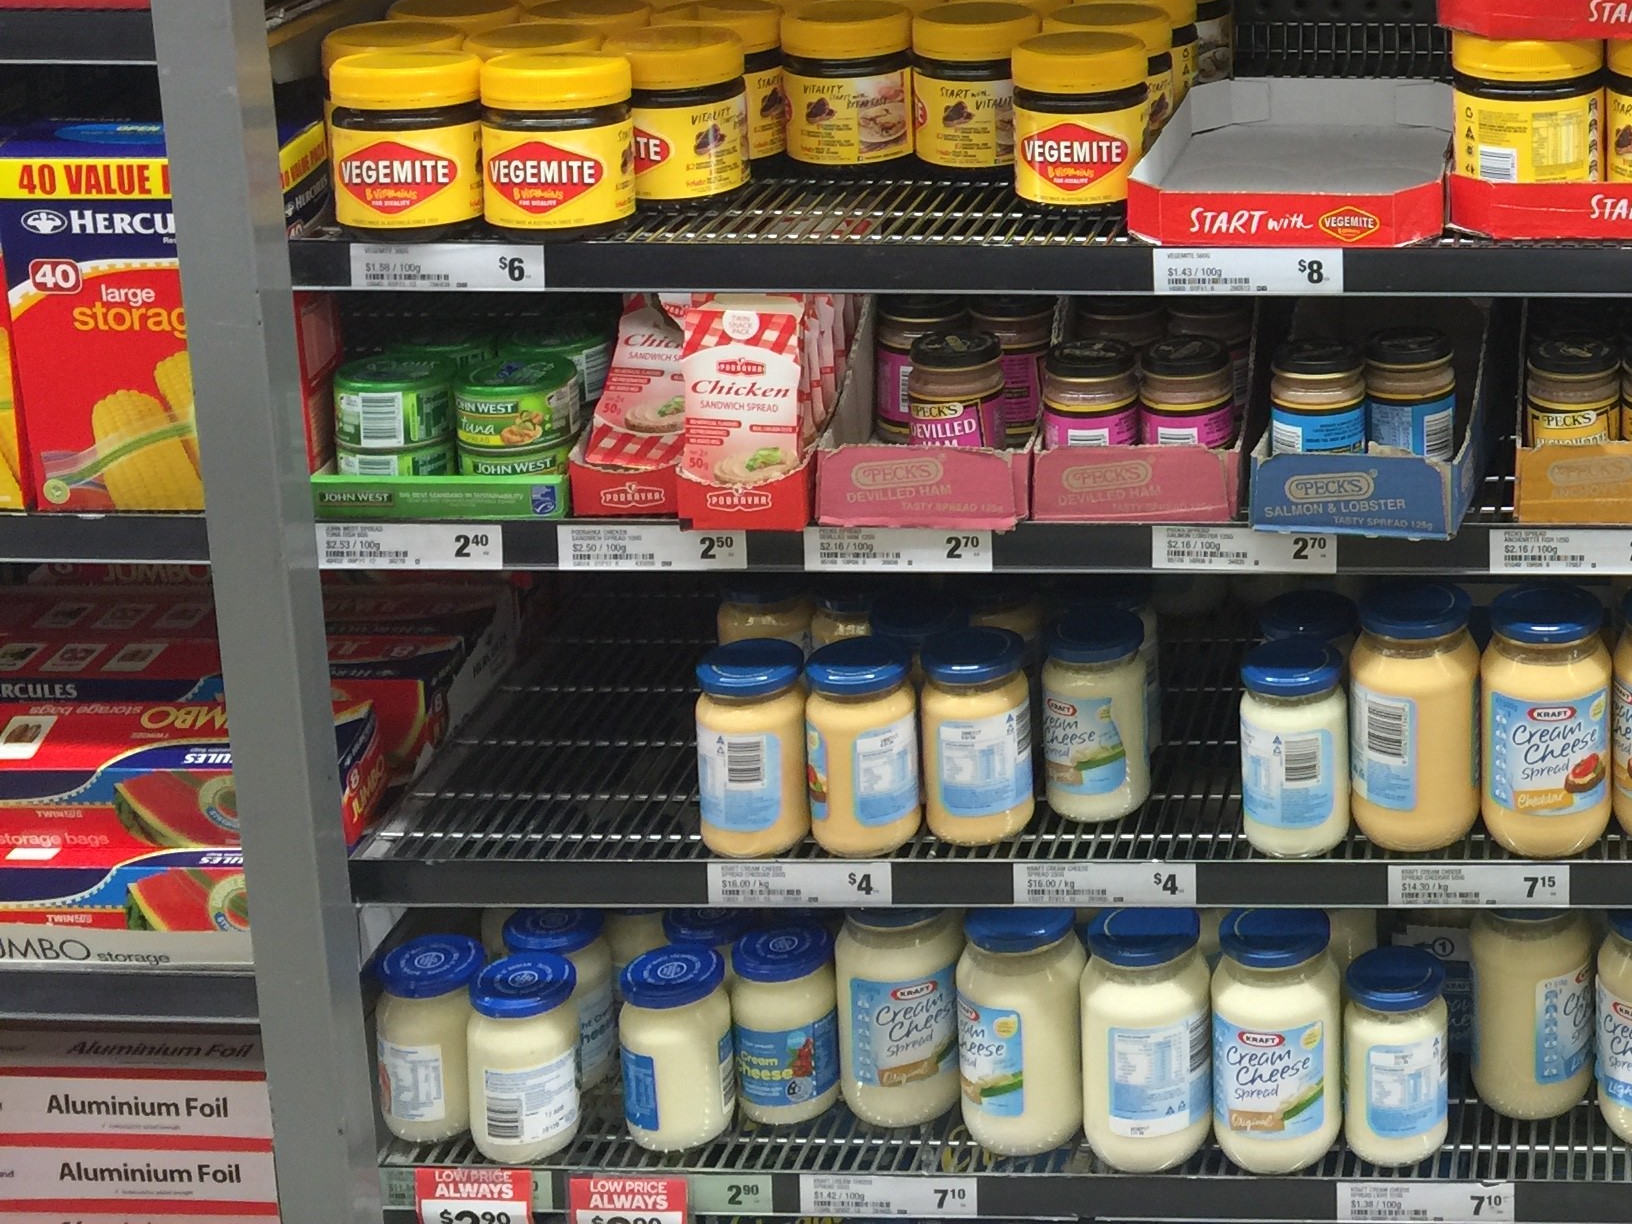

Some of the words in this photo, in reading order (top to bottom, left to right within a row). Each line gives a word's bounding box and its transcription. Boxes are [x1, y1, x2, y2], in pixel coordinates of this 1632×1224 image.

[18, 164, 57, 195] 40
[63, 163, 157, 195] VALUE
[340, 159, 457, 186] VEGEMITE
[1189, 206, 1267, 235] START
[1267, 211, 1313, 233] with
[1322, 214, 1375, 229] VEGEMITE
[101, 284, 155, 307] large
[690, 378, 791, 399] Chicken
[700, 400, 743, 411] SANDWICH
[745, 402, 779, 414] SPREAD
[910, 419, 977, 439] DEVILLED
[1295, 477, 1366, 496] PECK'S
[324, 492, 353, 503] JOHN
[355, 491, 391, 503] WEST
[707, 495, 772, 510] PODRAVKA
[326, 540, 349, 549] $2.53
[359, 540, 380, 551] 100g
[1535, 708, 1569, 719] KRAFT
[1511, 720, 1583, 747] Cream
[1523, 730, 1597, 767] Cheese
[46, 1095, 180, 1118] Aluminium
[185, 1096, 229, 1118] Foil
[589, 1180, 619, 1194] LOW
[621, 1181, 667, 1194] PRICE
[589, 1193, 669, 1210] ALWAYS
